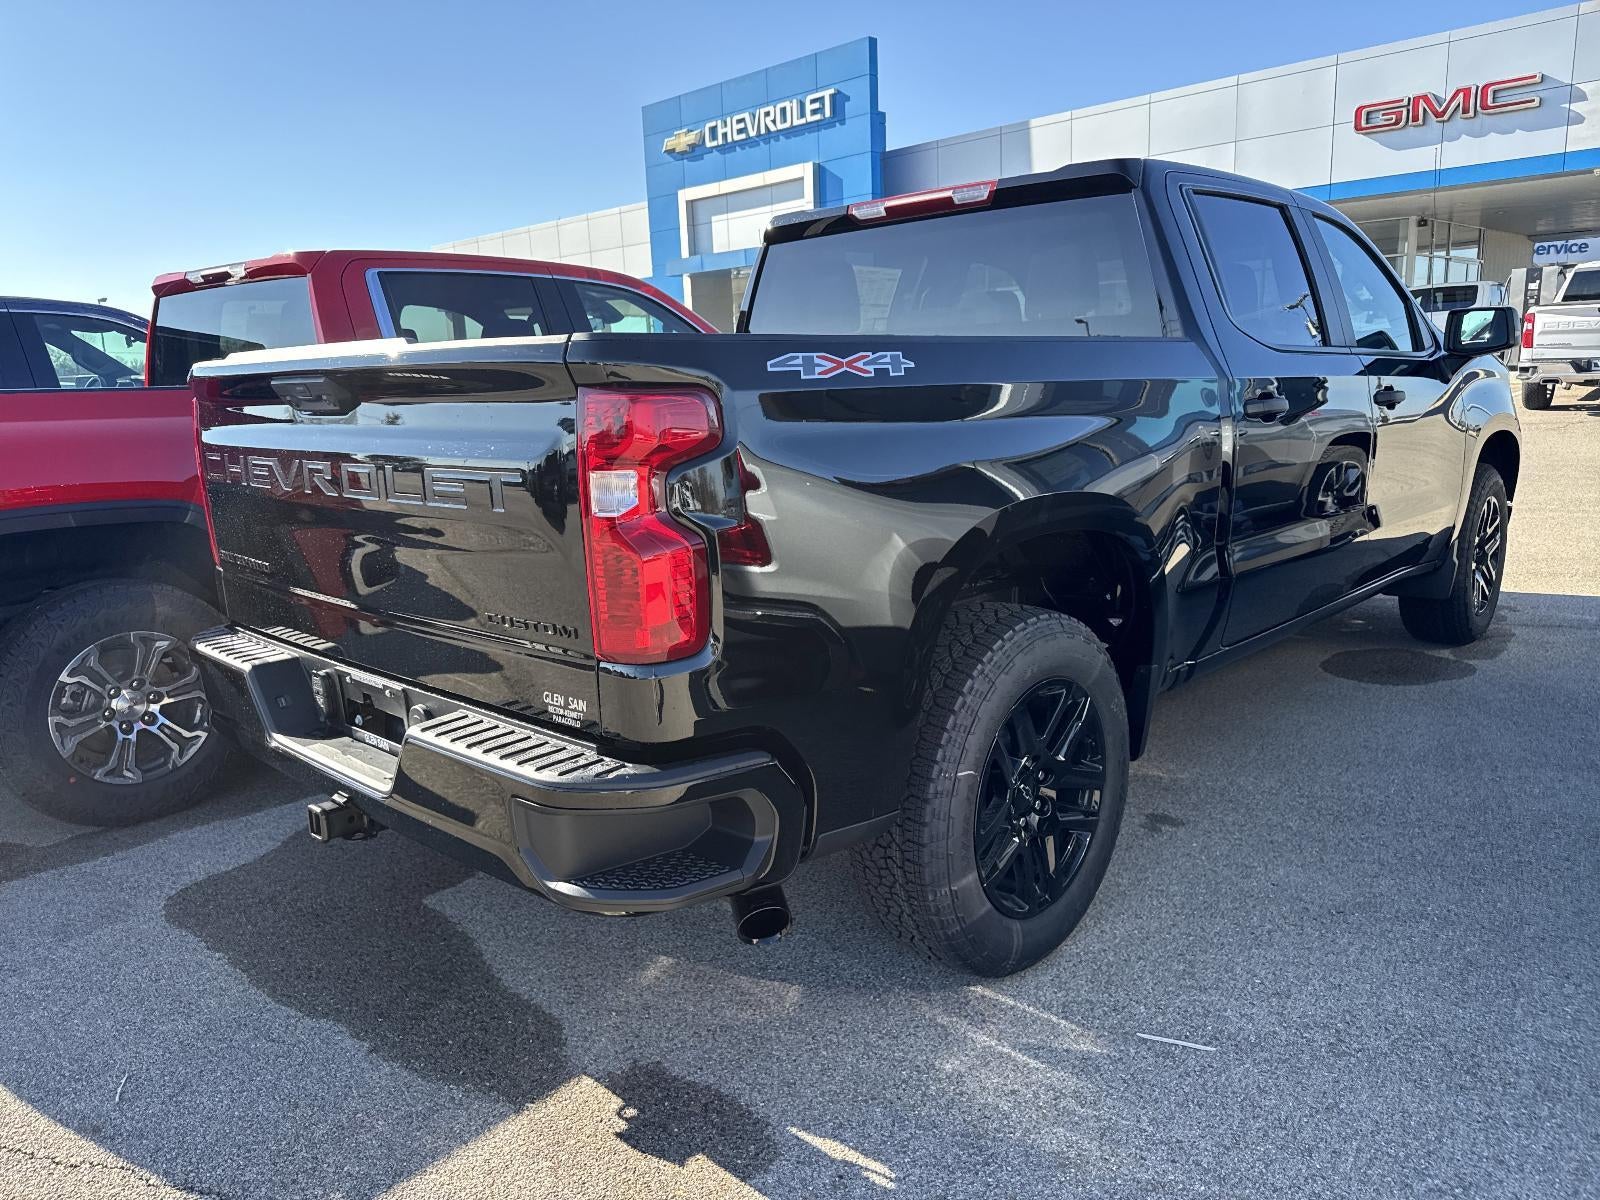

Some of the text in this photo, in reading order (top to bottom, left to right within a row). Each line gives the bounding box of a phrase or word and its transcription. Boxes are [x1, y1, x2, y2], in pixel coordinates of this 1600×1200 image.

[704, 87, 839, 148] CHEVROLET
[1353, 72, 1543, 134] GMC
[1535, 240, 1590, 256] ervice
[205, 451, 522, 513] CHEVROLET
[485, 612, 579, 639] CUSTOM
[543, 691, 587, 712] GLEN SAIN
